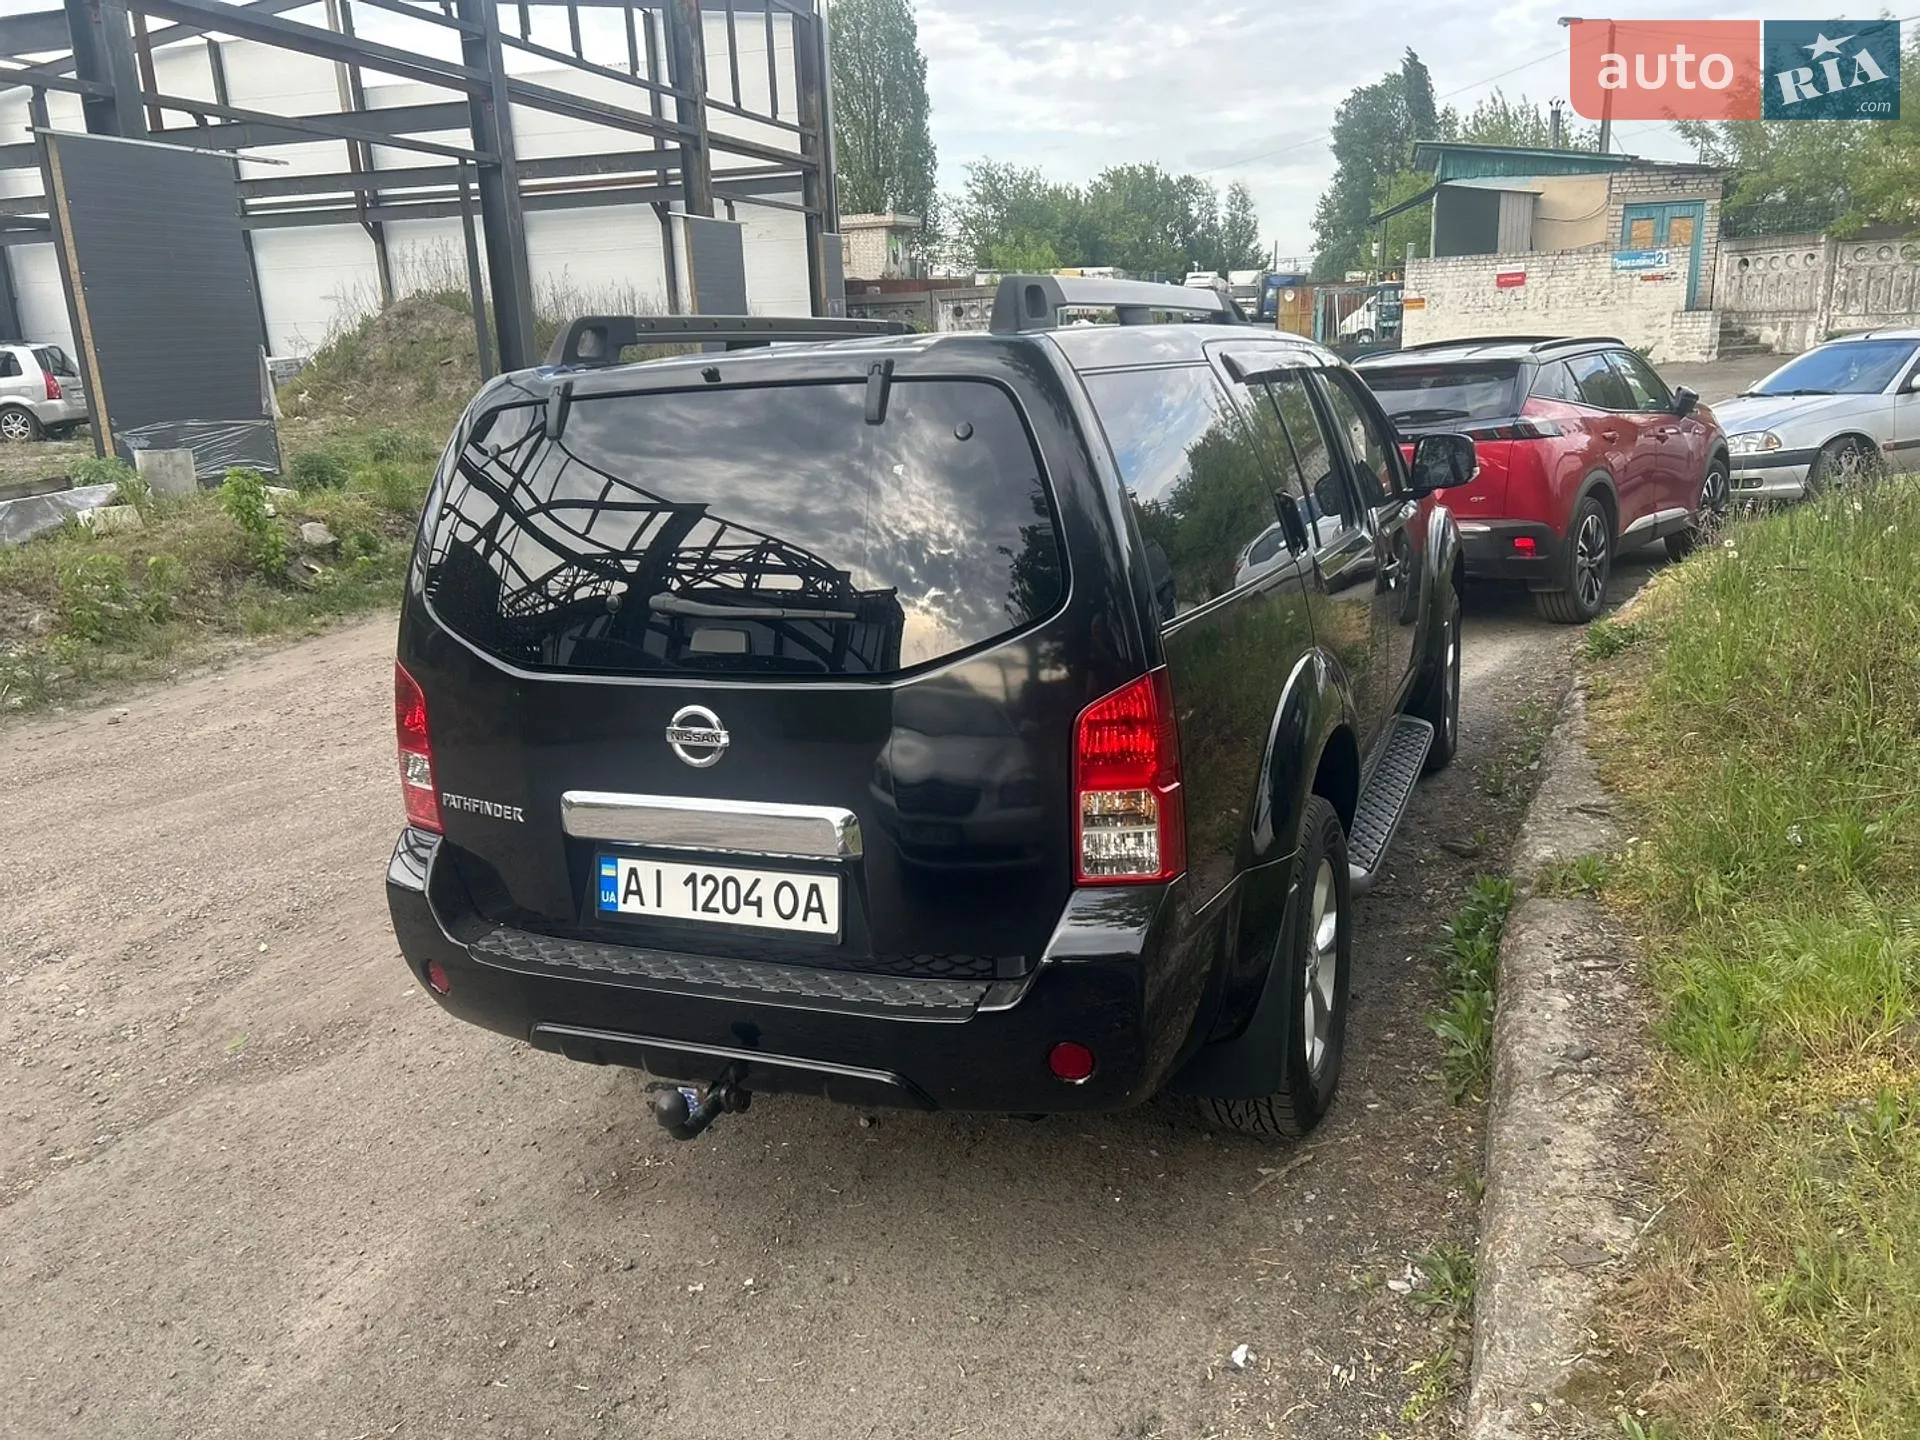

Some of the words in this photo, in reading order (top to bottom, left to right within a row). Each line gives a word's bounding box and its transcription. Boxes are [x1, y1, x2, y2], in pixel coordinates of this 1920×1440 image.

[1656, 251, 1669, 265] 21
[670, 730, 721, 743] NISSAN
[442, 792, 524, 823] PATHFINDER
[602, 890, 617, 903] UA
[622, 867, 662, 908] AI
[683, 872, 763, 918] 1204
[773, 880, 828, 924] OA
